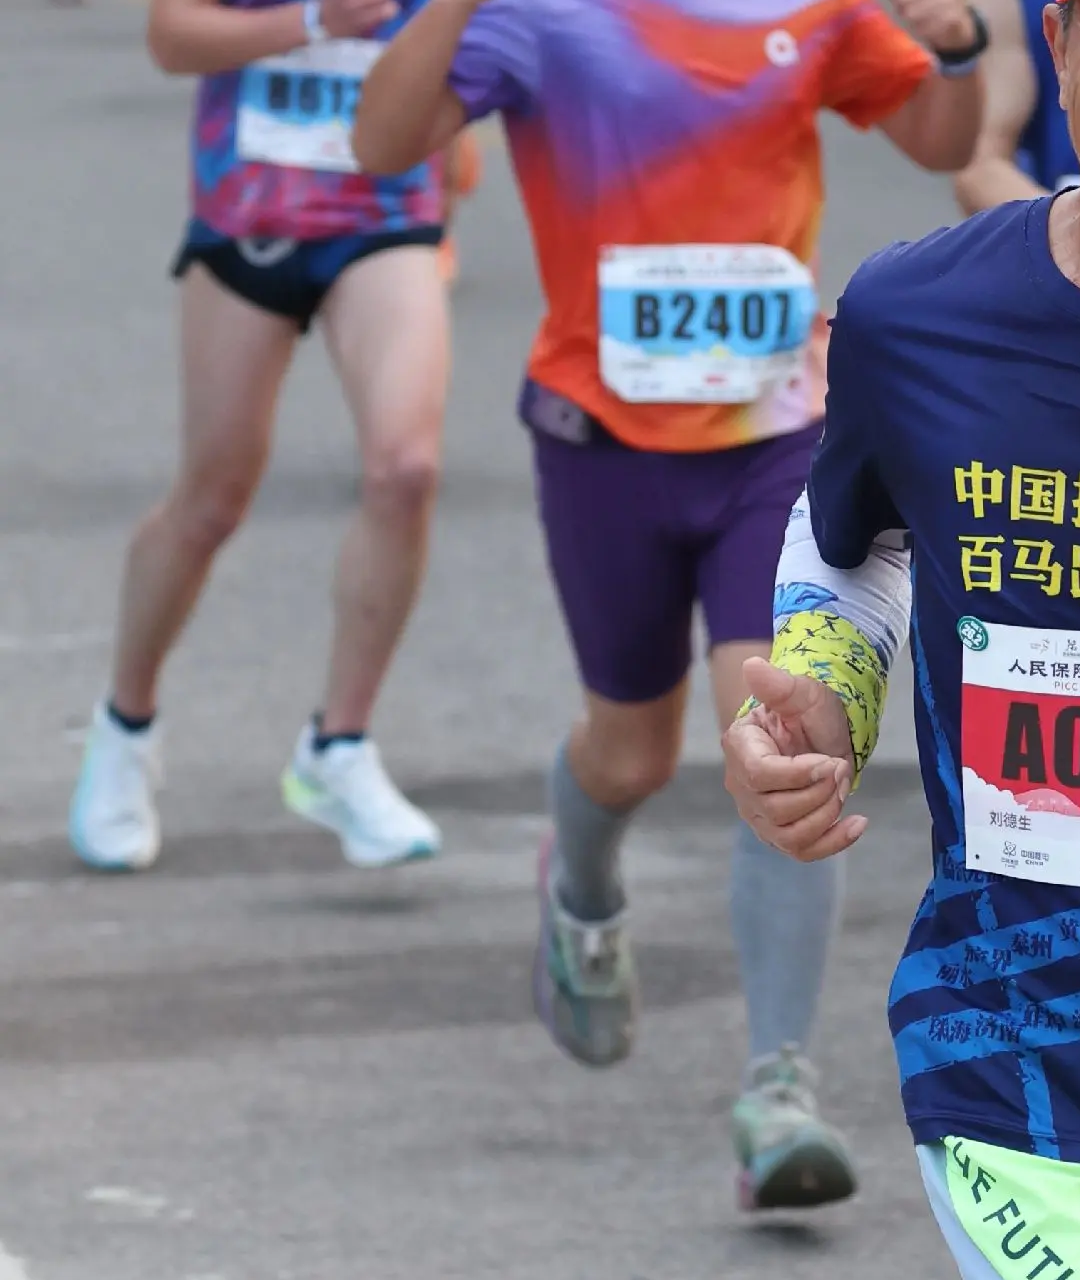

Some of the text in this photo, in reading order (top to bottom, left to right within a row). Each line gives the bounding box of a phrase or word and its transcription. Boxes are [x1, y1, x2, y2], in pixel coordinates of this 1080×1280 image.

[634, 292, 790, 340] B2407
[989, 811, 1032, 831] 刘德生
